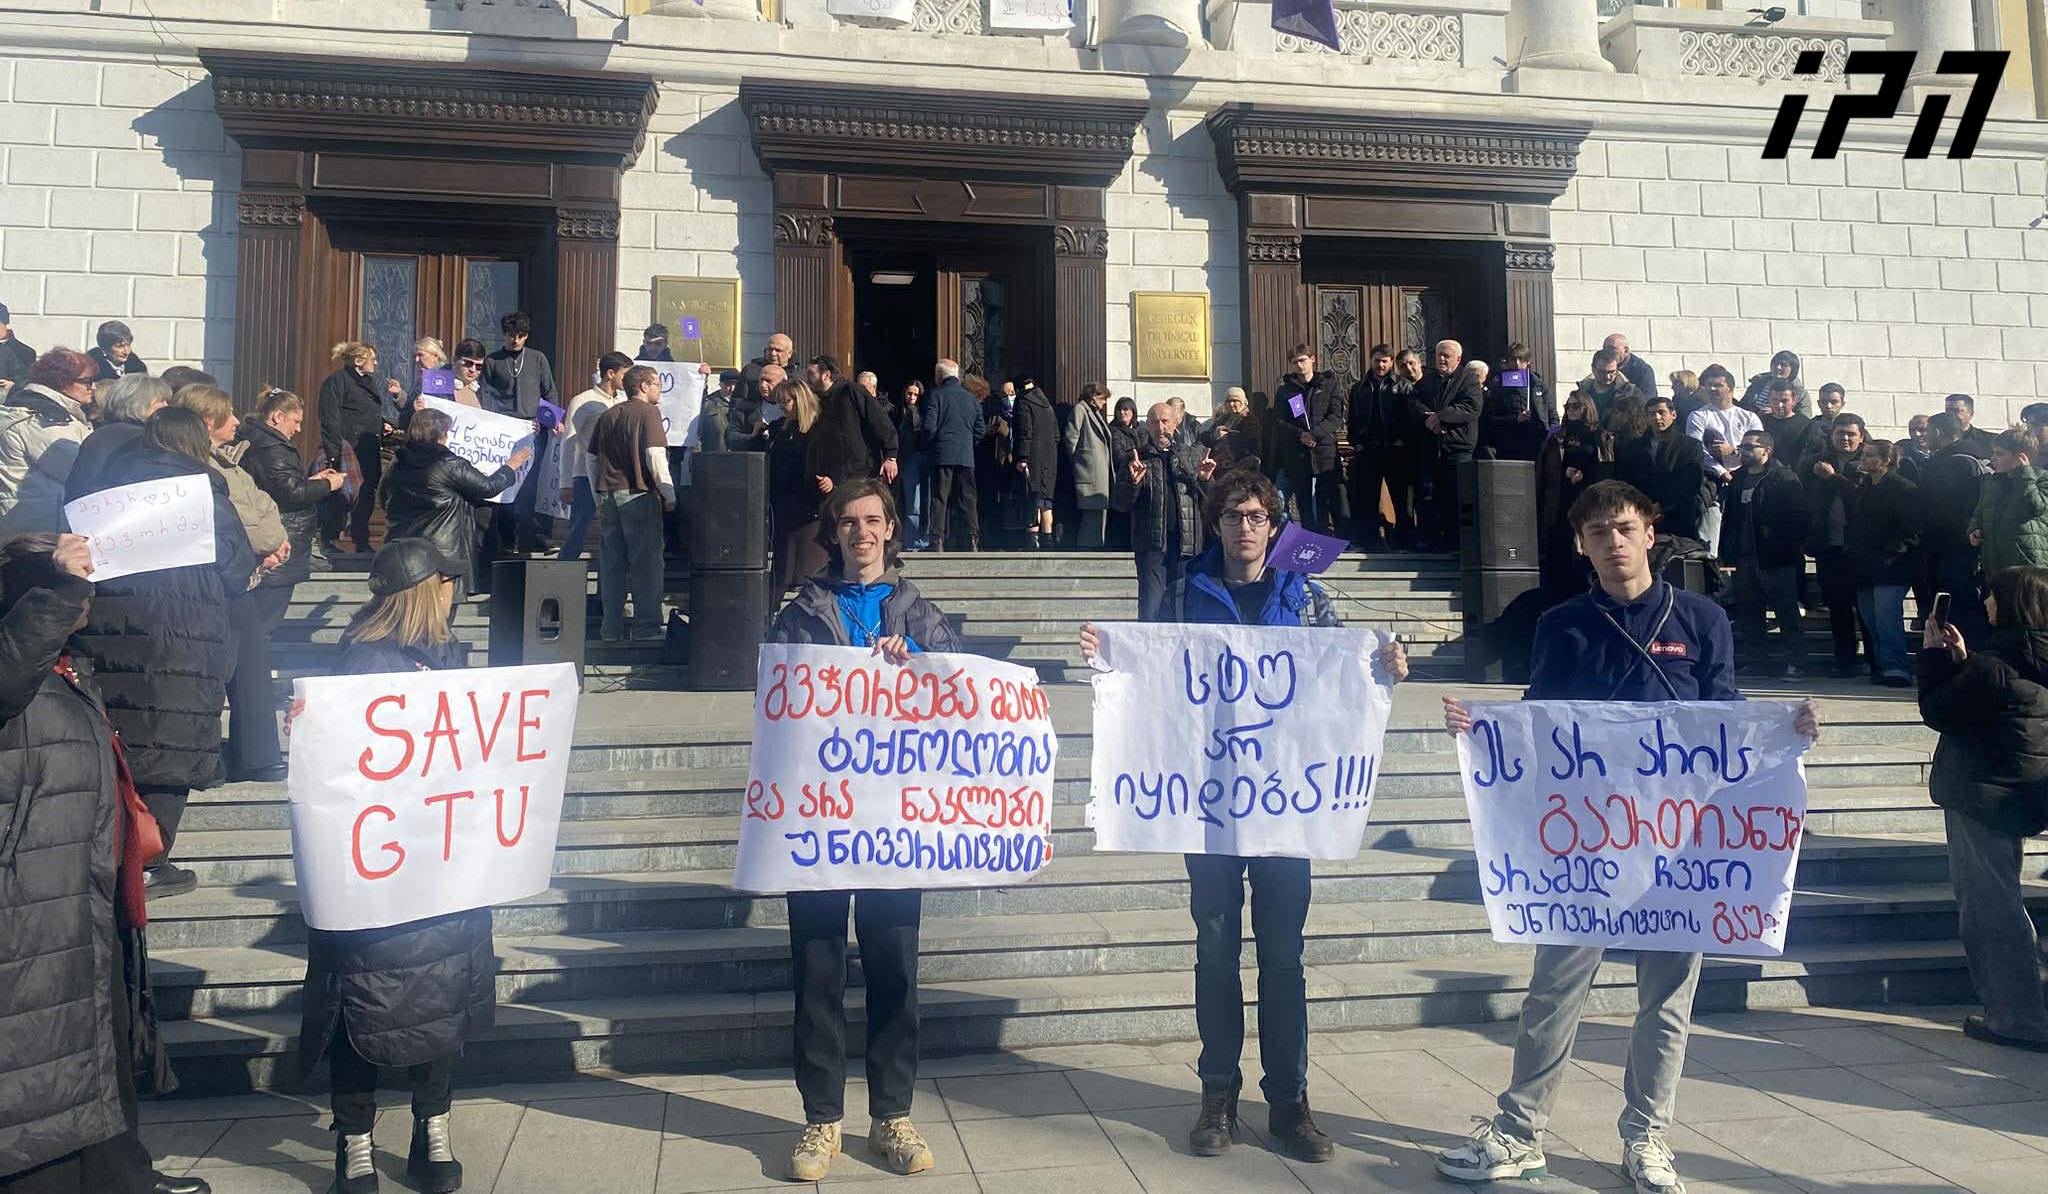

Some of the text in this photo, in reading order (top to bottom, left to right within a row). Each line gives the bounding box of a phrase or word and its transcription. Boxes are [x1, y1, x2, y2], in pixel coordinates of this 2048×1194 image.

[1145, 330, 1199, 342] TECHNICAL
[1148, 312, 1197, 325] GEORGIAN
[1144, 347, 1200, 360] UNIVERSITY
[1651, 643, 1684, 653] Lenovo
[764, 662, 1049, 724] გვჭირდება მეტი
[1183, 645, 1298, 710] სტუ
[358, 689, 551, 782] SAVE
[818, 727, 1051, 778] ტექნოლოგია
[1203, 718, 1274, 763] არ
[1472, 718, 1753, 788] ეს არ არის
[747, 779, 1045, 828] და არა ნაკლები
[1539, 793, 1805, 857] გაერთიანებ
[351, 785, 530, 881] GTU
[1487, 852, 1752, 898] არამედ ჩვენი
[1506, 902, 1702, 937] უნივერსიტეტის
